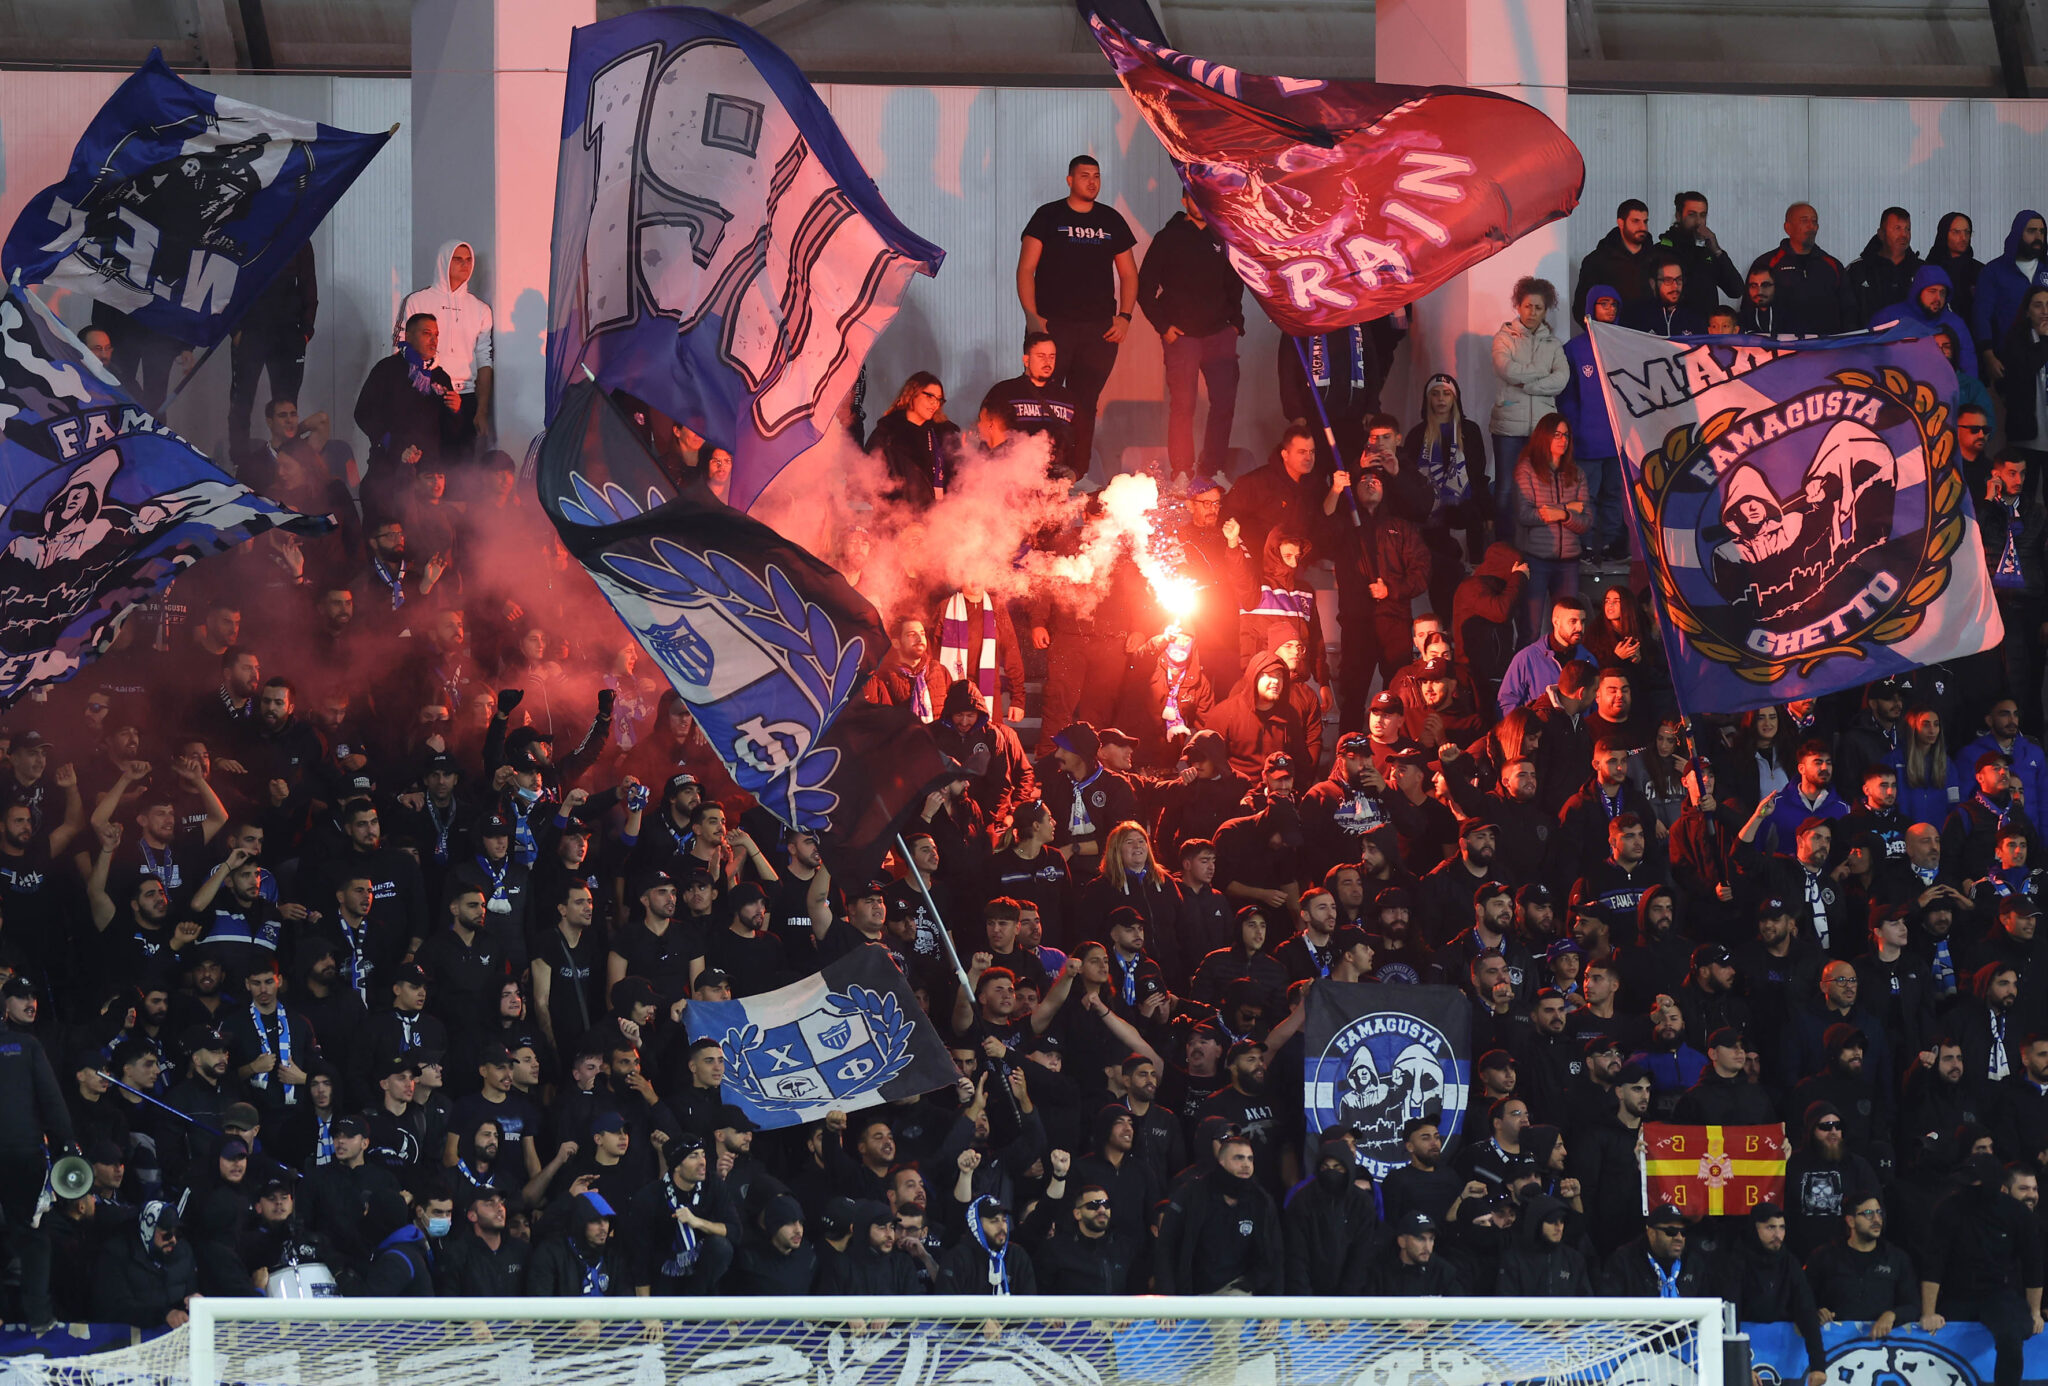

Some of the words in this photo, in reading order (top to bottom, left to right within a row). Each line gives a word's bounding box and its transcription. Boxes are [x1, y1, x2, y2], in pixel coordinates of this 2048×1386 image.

[1068, 226, 1105, 239] 1994
[1691, 391, 1882, 486] FAMAGUSTA
[1746, 568, 1901, 656] GHETTO
[1336, 1017, 1442, 1055] FAMAGUSTA
[837, 1057, 875, 1081] Φ
[1244, 1106, 1273, 1121] AK47
